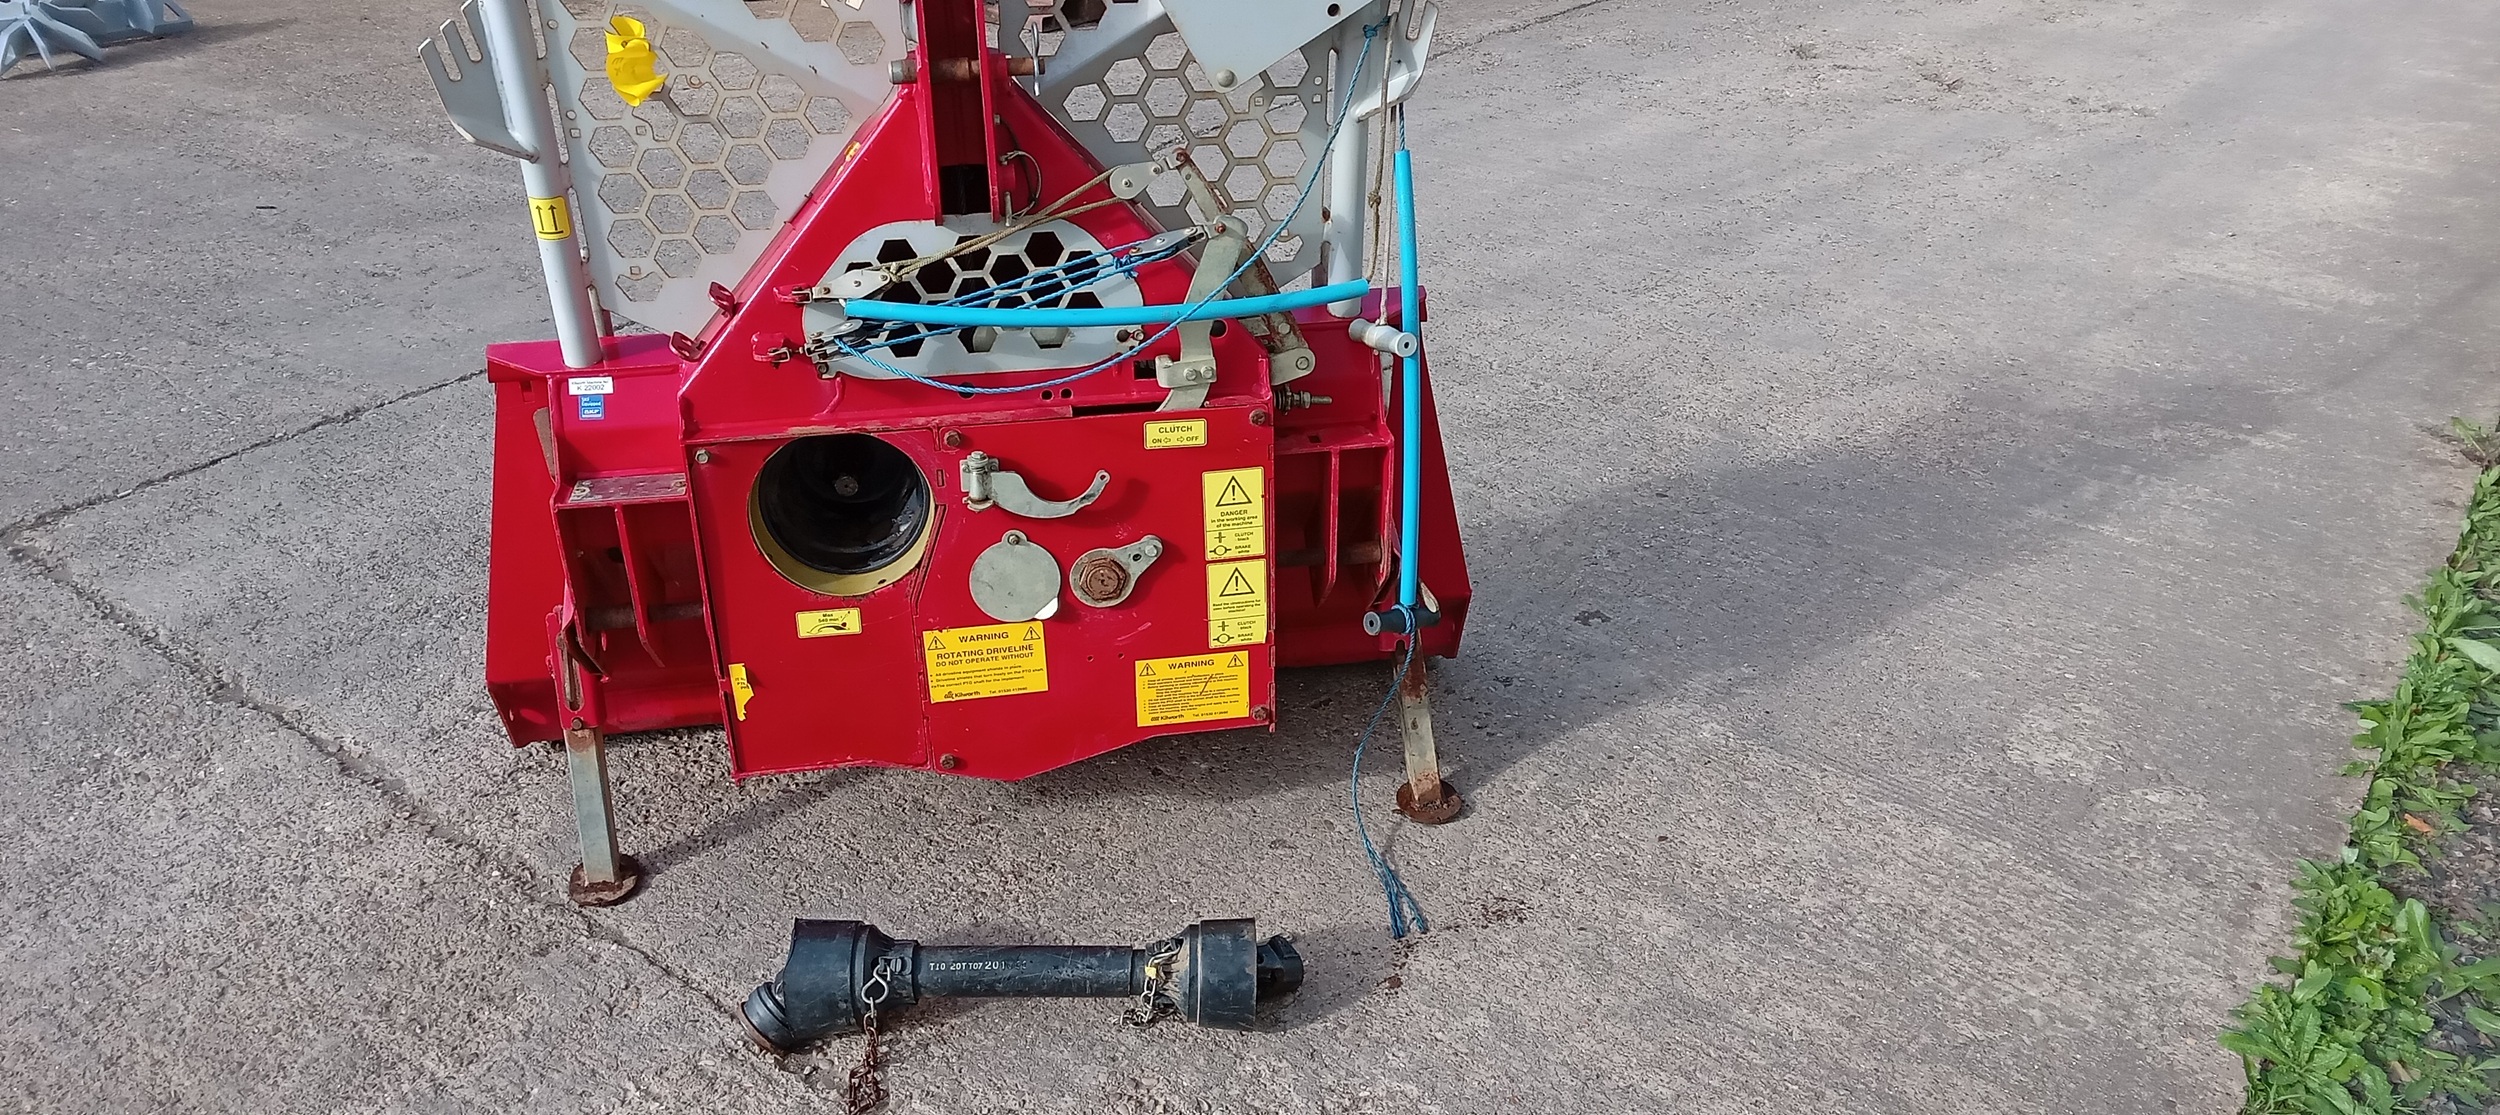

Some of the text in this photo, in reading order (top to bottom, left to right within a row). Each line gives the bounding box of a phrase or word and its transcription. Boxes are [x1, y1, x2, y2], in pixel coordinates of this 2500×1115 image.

[1158, 425, 1193, 434] CLUTCH
[1220, 509, 1248, 517] DANGER
[958, 631, 1009, 643] WARNING
[936, 644, 1034, 660] ROTATING DRIVELINE
[965, 656, 1000, 664] OPERATE
[1001, 652, 1034, 660] WITHOUT
[1168, 659, 1215, 670] WARNING
[1160, 713, 1185, 721] Kilworth
